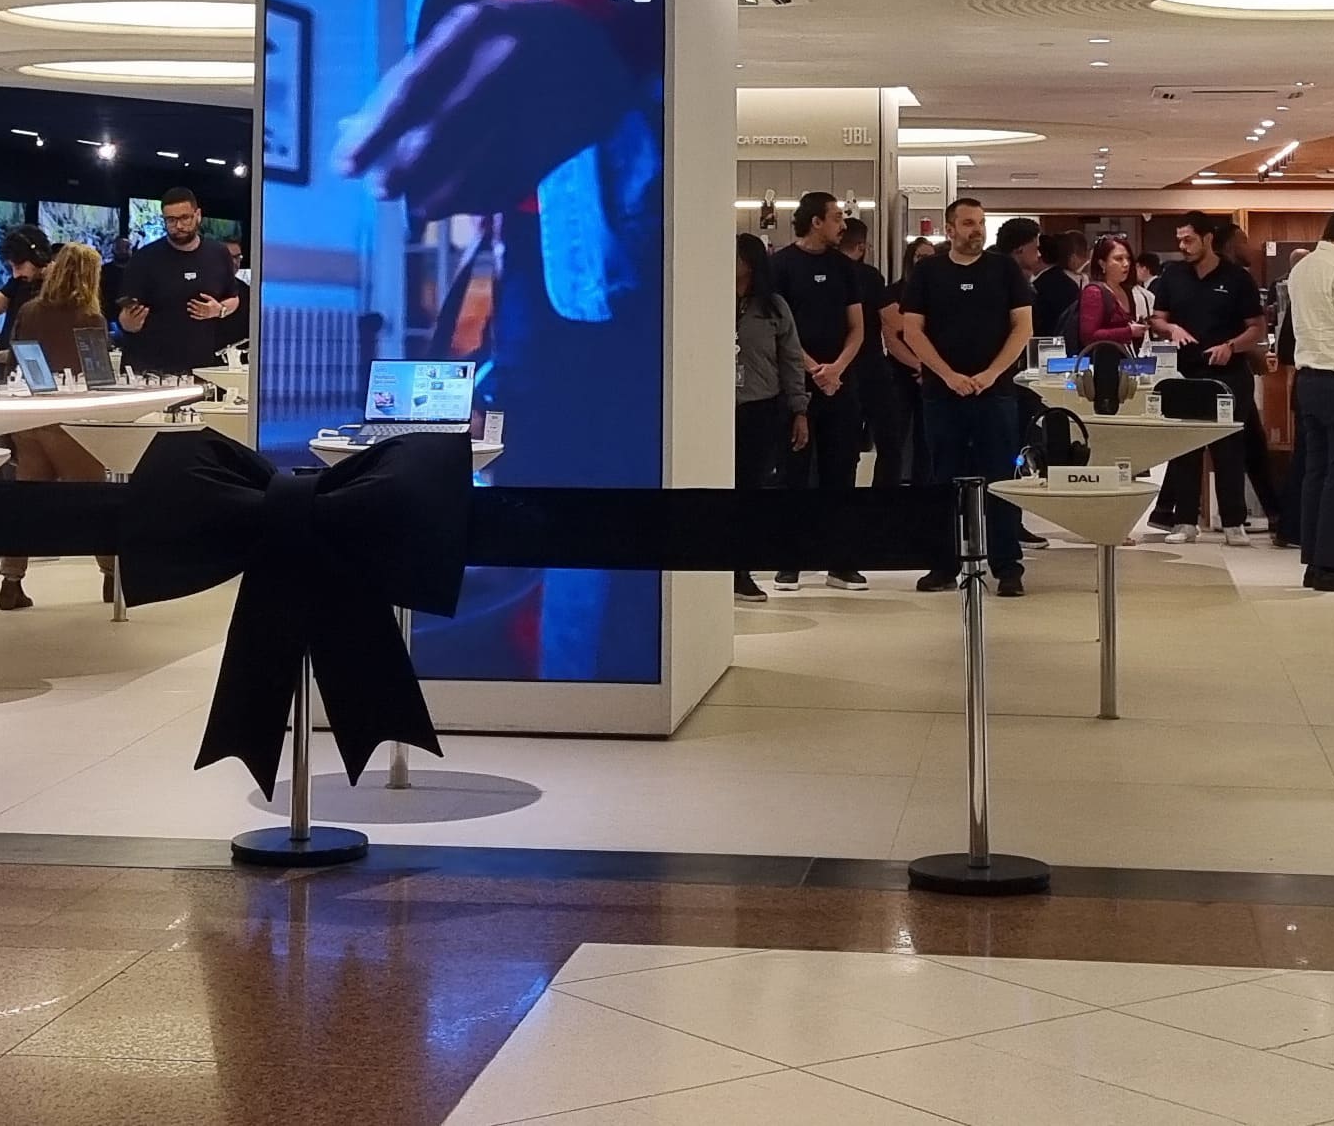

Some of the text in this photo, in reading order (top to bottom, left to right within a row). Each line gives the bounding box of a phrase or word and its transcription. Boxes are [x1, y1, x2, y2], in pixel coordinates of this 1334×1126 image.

[753, 135, 809, 146] PREFERIDA
[842, 126, 873, 146] JBL
[1068, 475, 1099, 483] DALI
